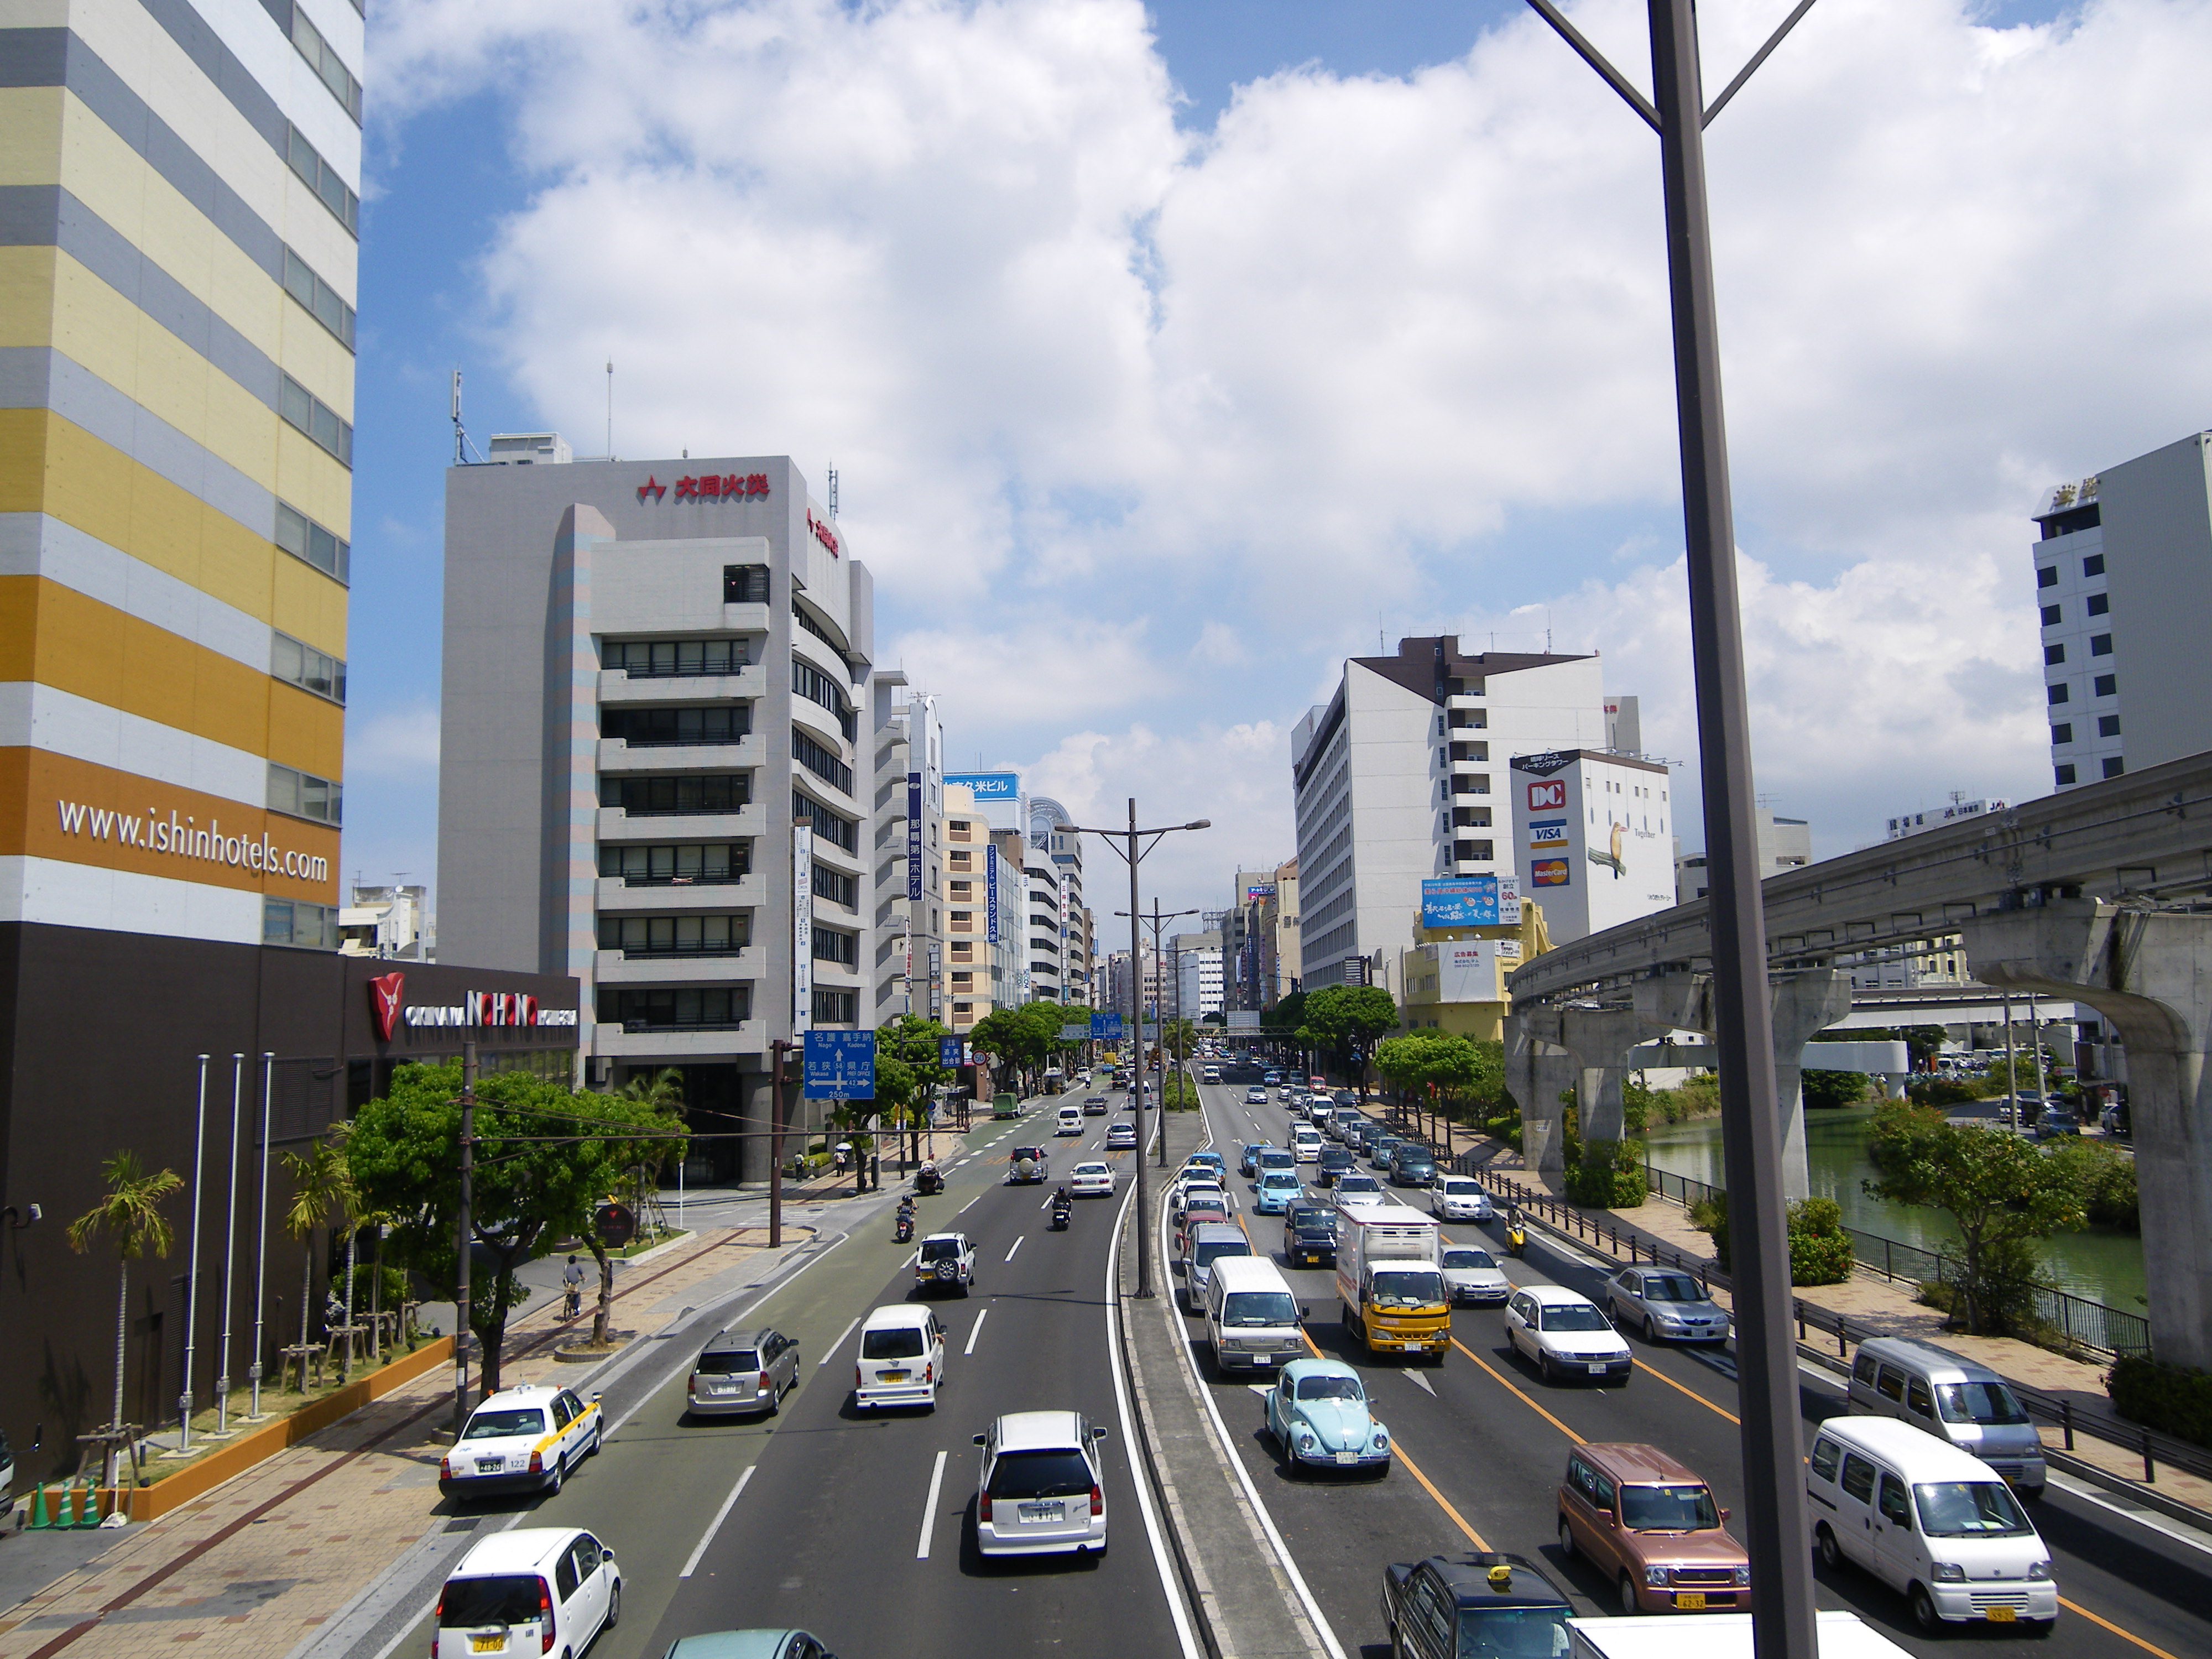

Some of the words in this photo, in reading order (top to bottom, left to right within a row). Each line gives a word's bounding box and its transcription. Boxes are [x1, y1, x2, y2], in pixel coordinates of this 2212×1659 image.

[675, 474, 770, 497] 大同火災
[945, 780, 1008, 792] 久米ビル
[1531, 784, 1562, 807] DC
[1536, 828, 1561, 840] VISA
[1635, 828, 1656, 839] Together
[58, 800, 328, 881] www.ishinhotels.com
[910, 819, 921, 897] 那覇第一ホテル
[1535, 868, 1567, 878] MasterCard
[405, 1005, 466, 1027] OKINAWA
[814, 1032, 836, 1042] 名護
[842, 1032, 872, 1042] 嘉手納
[807, 1061, 831, 1071] 若狭
[847, 1061, 870, 1071] 県庁
[1682, 1599, 1705, 1609] 62-32
[481, 1639, 503, 1650] 71-00
